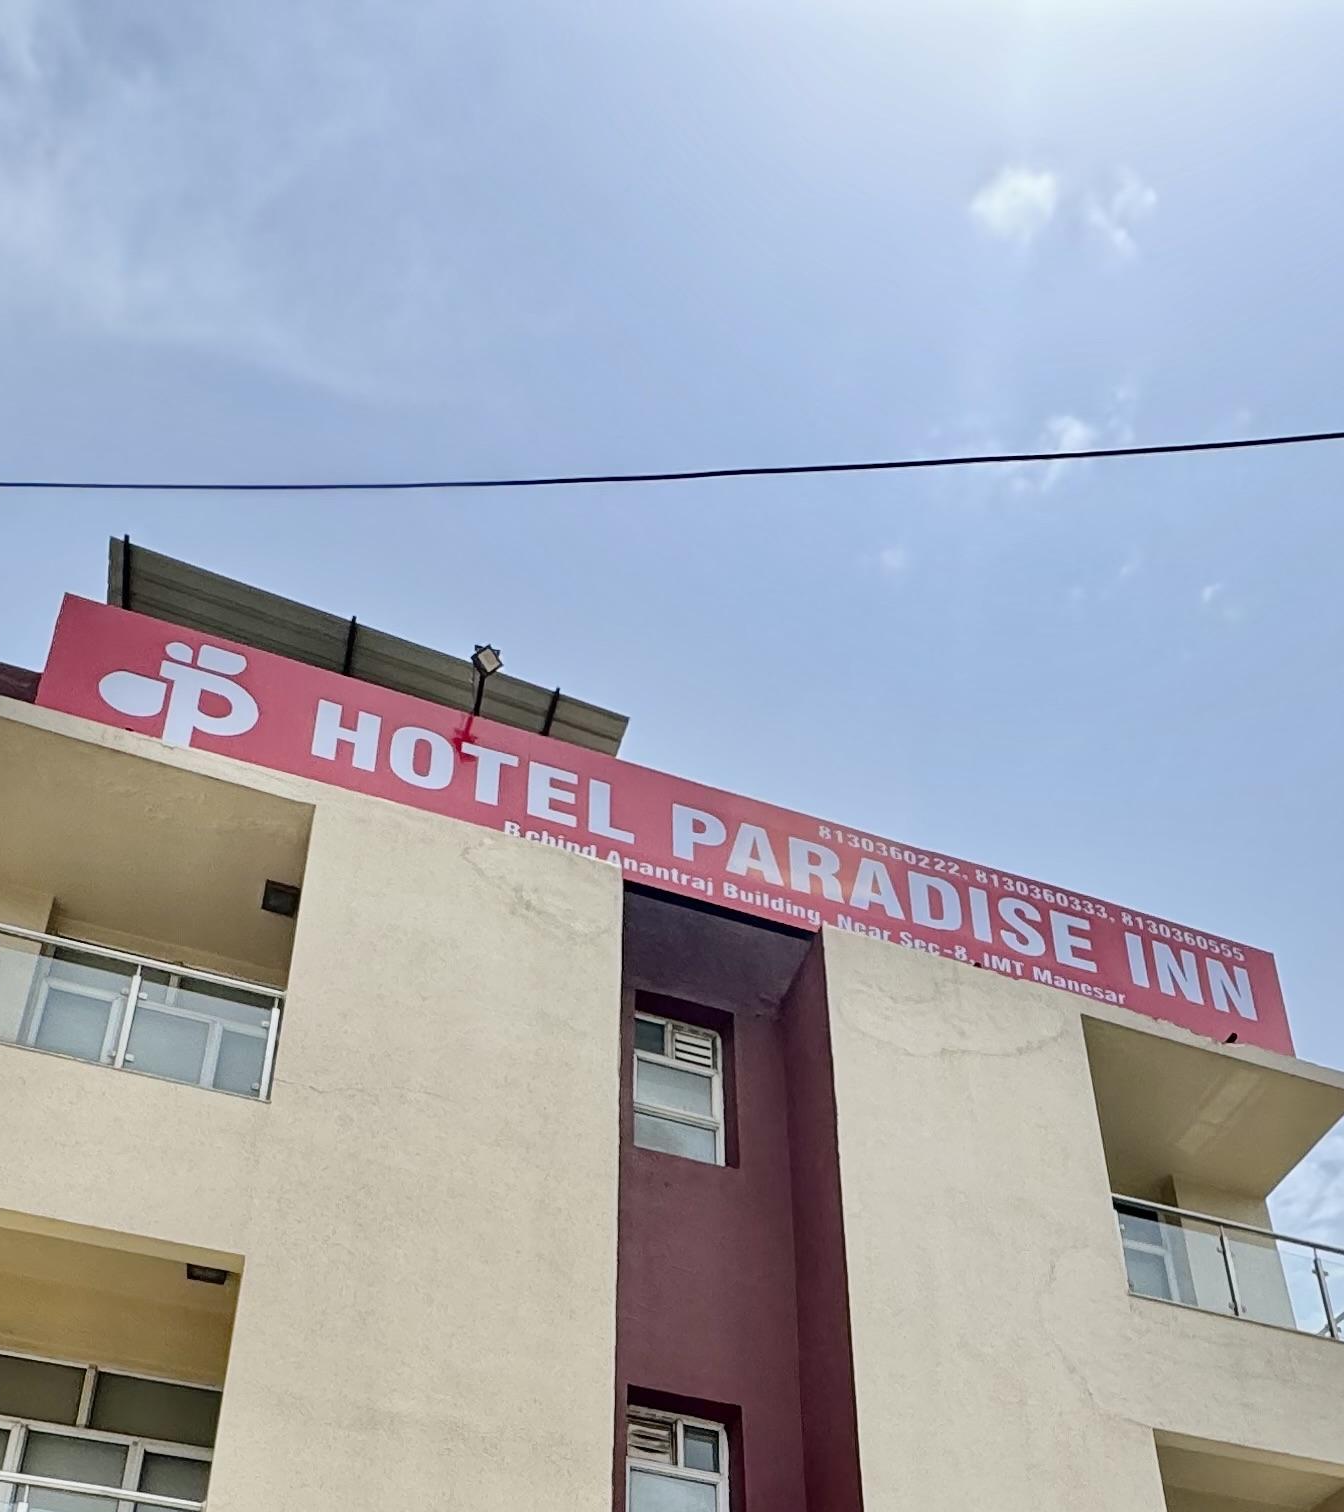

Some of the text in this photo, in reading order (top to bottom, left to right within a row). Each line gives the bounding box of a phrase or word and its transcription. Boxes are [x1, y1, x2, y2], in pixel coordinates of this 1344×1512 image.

[310, 698, 1258, 1021] HOTEL PARADISE INN
[606, 850, 713, 896] Anantraj
[983, 951, 1024, 977] IMT
[1121, 911, 1245, 962] 8130360555
